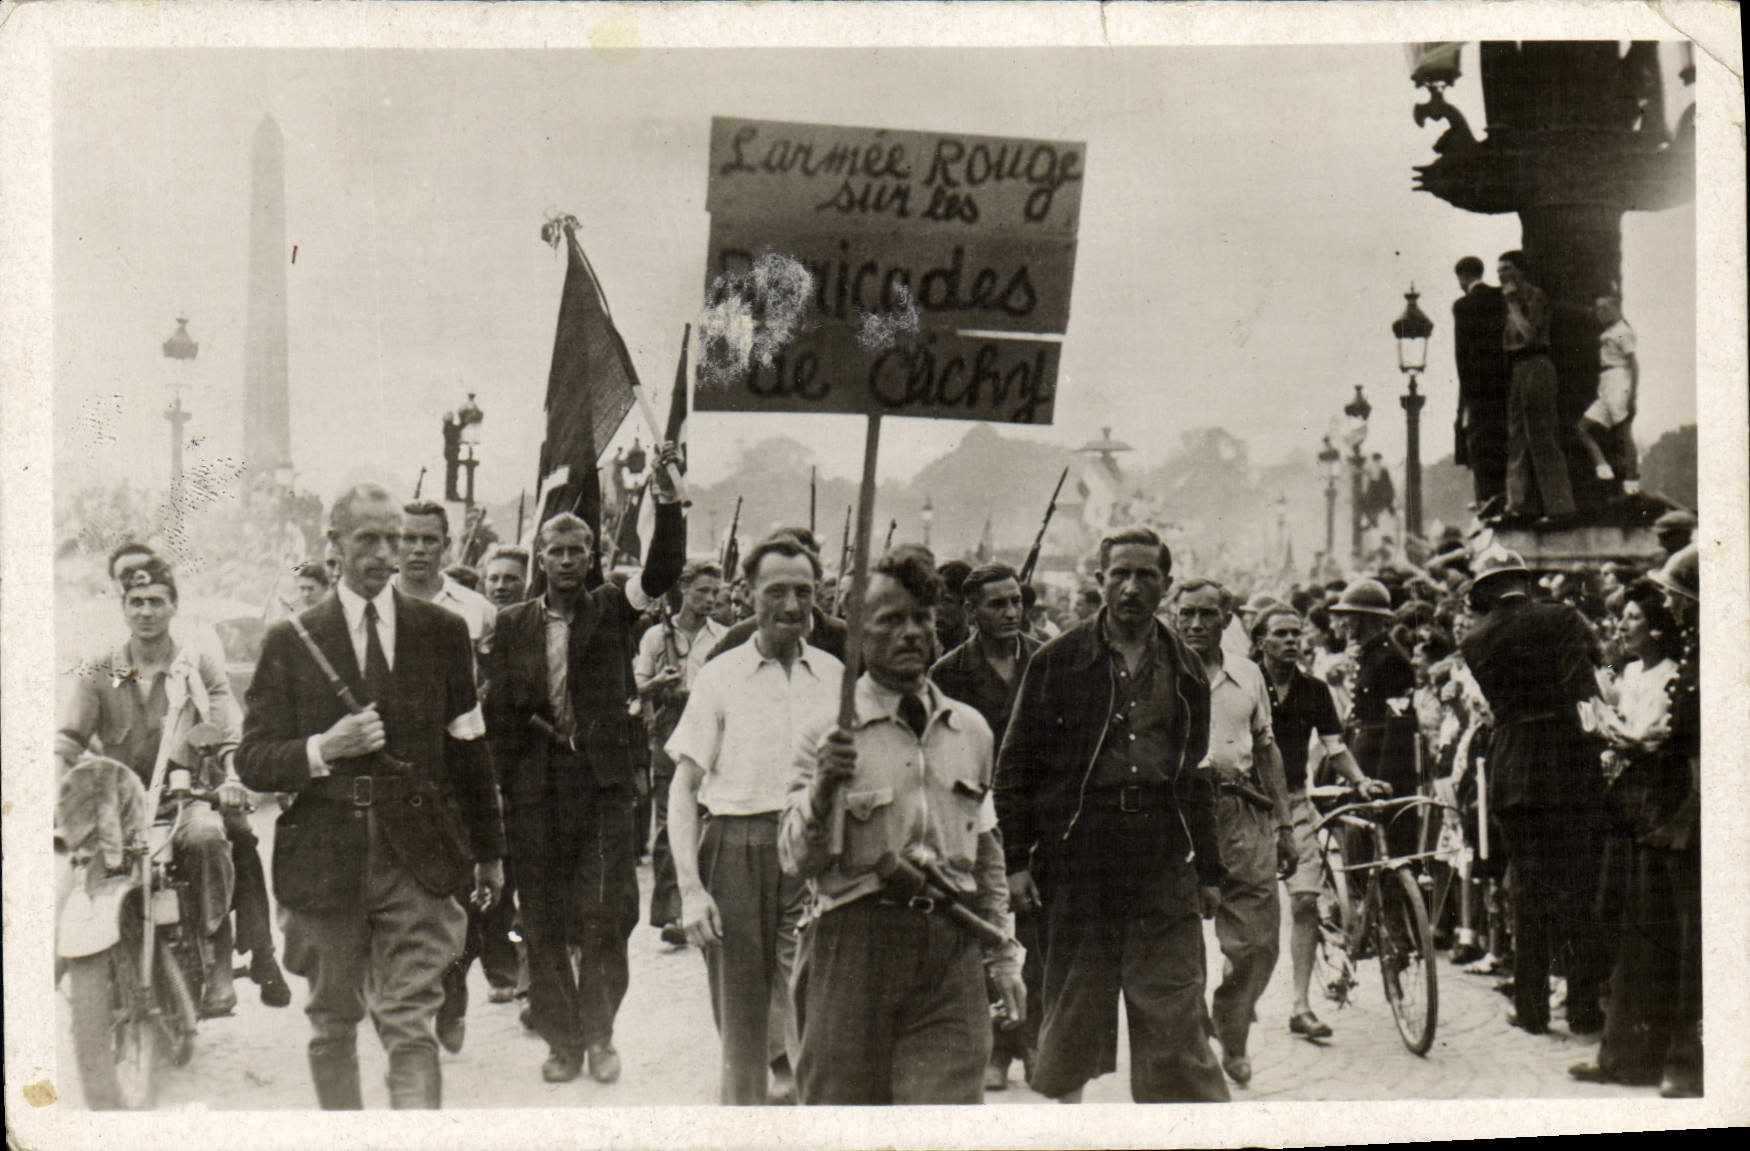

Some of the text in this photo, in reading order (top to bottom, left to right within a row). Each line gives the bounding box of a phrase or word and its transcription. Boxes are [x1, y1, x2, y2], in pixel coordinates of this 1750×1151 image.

[814, 178, 980, 224] sur les
[921, 138, 1083, 223] Rouge
